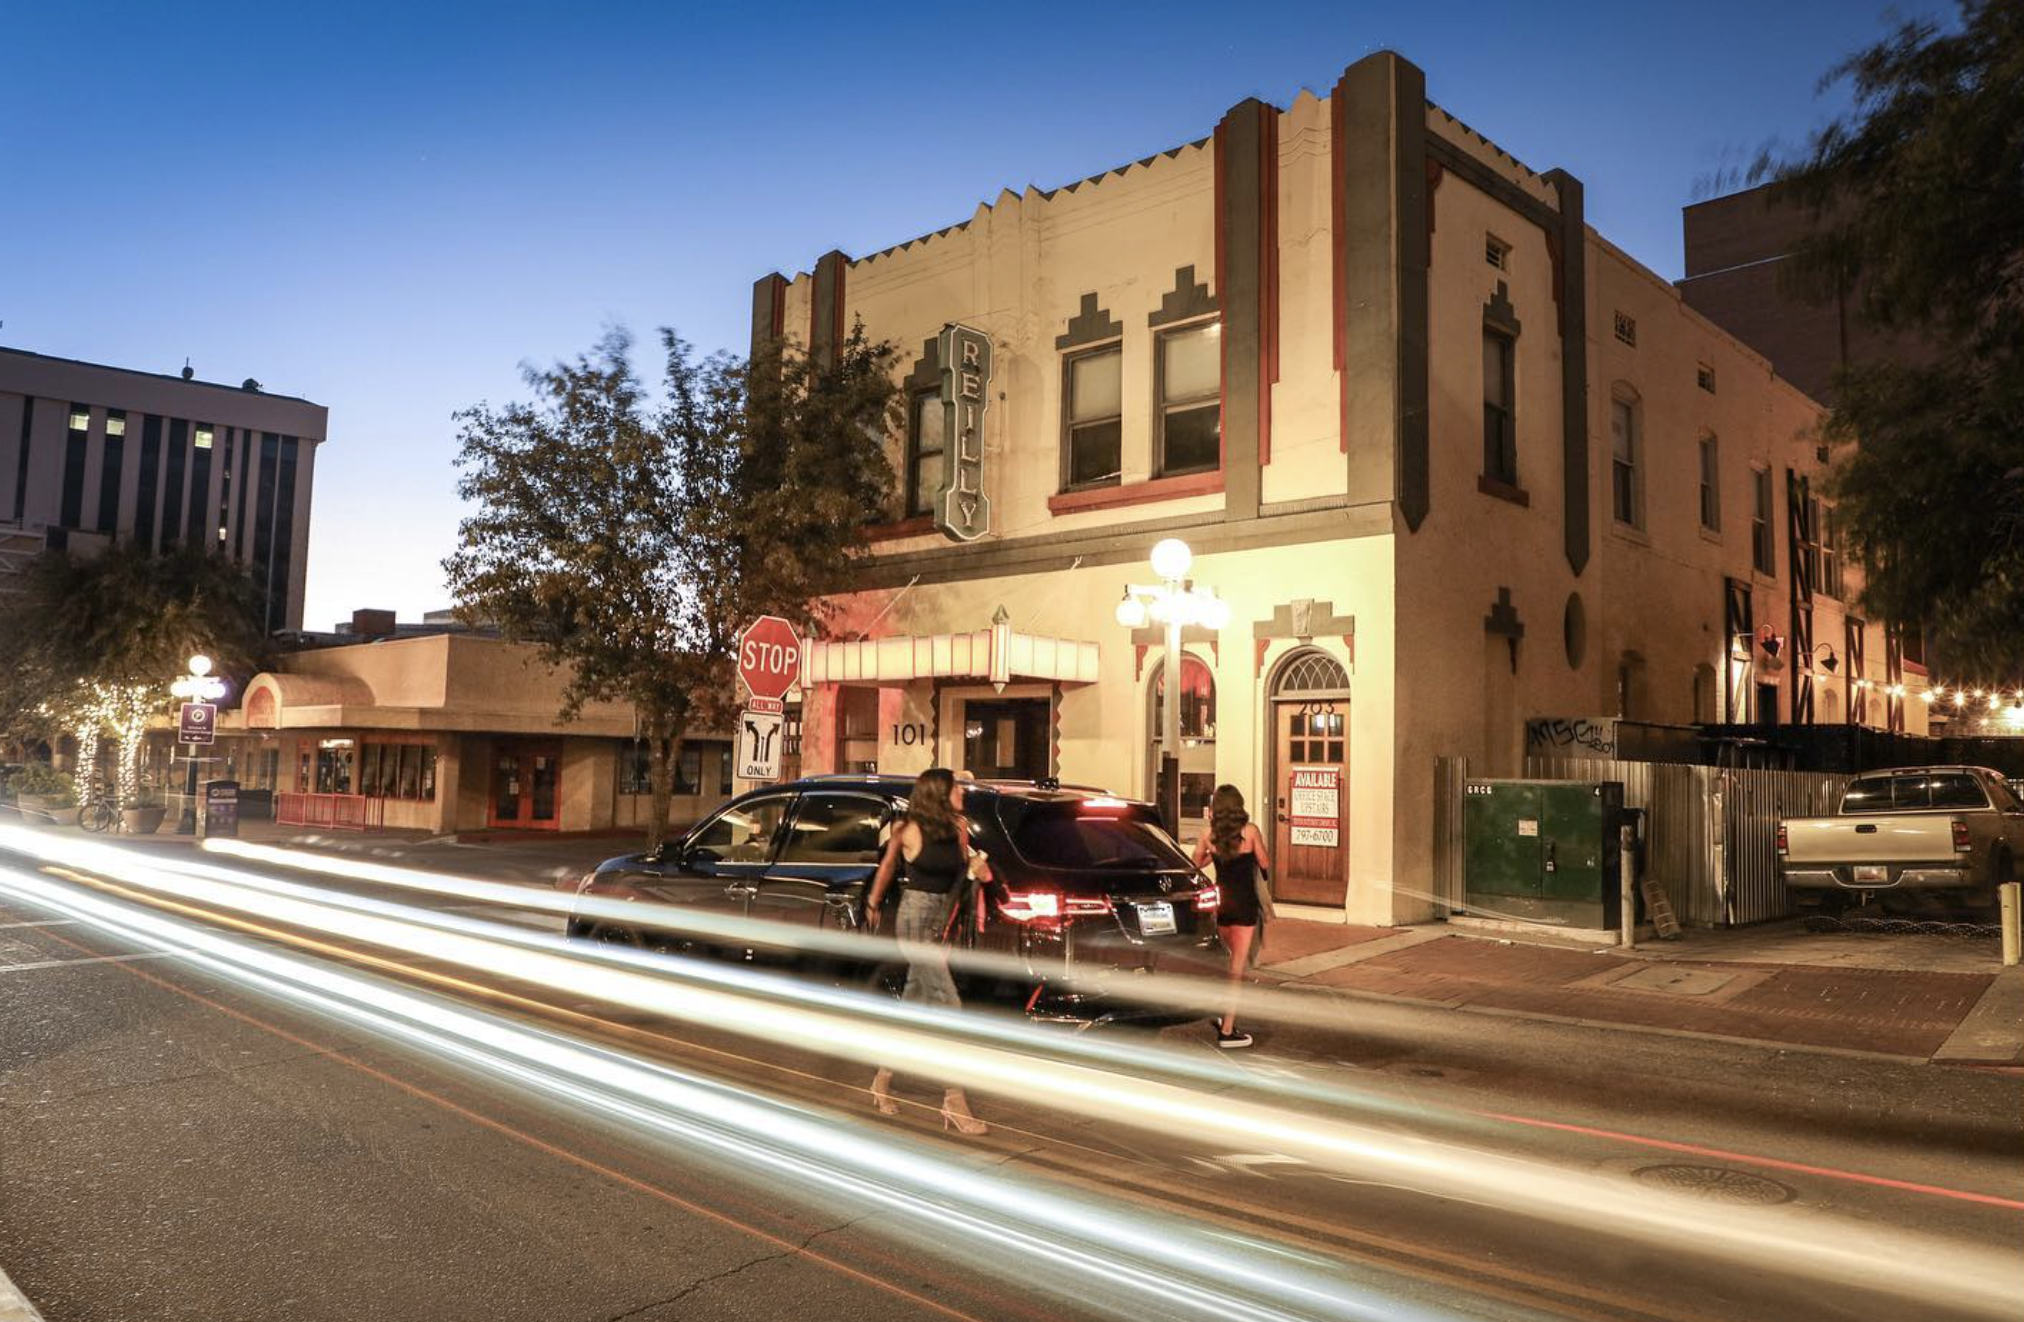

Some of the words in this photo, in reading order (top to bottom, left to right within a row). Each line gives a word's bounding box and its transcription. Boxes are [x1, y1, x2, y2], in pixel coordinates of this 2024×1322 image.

[959, 340, 981, 526] REILLY
[743, 640, 797, 675] STOP
[752, 700, 764, 710] ALL
[767, 702, 780, 711] WAY
[892, 723, 925, 746] 101
[747, 765, 771, 777] ONLY
[1295, 771, 1337, 788] AVAILABLE
[1296, 829, 1334, 843] 797-6700
